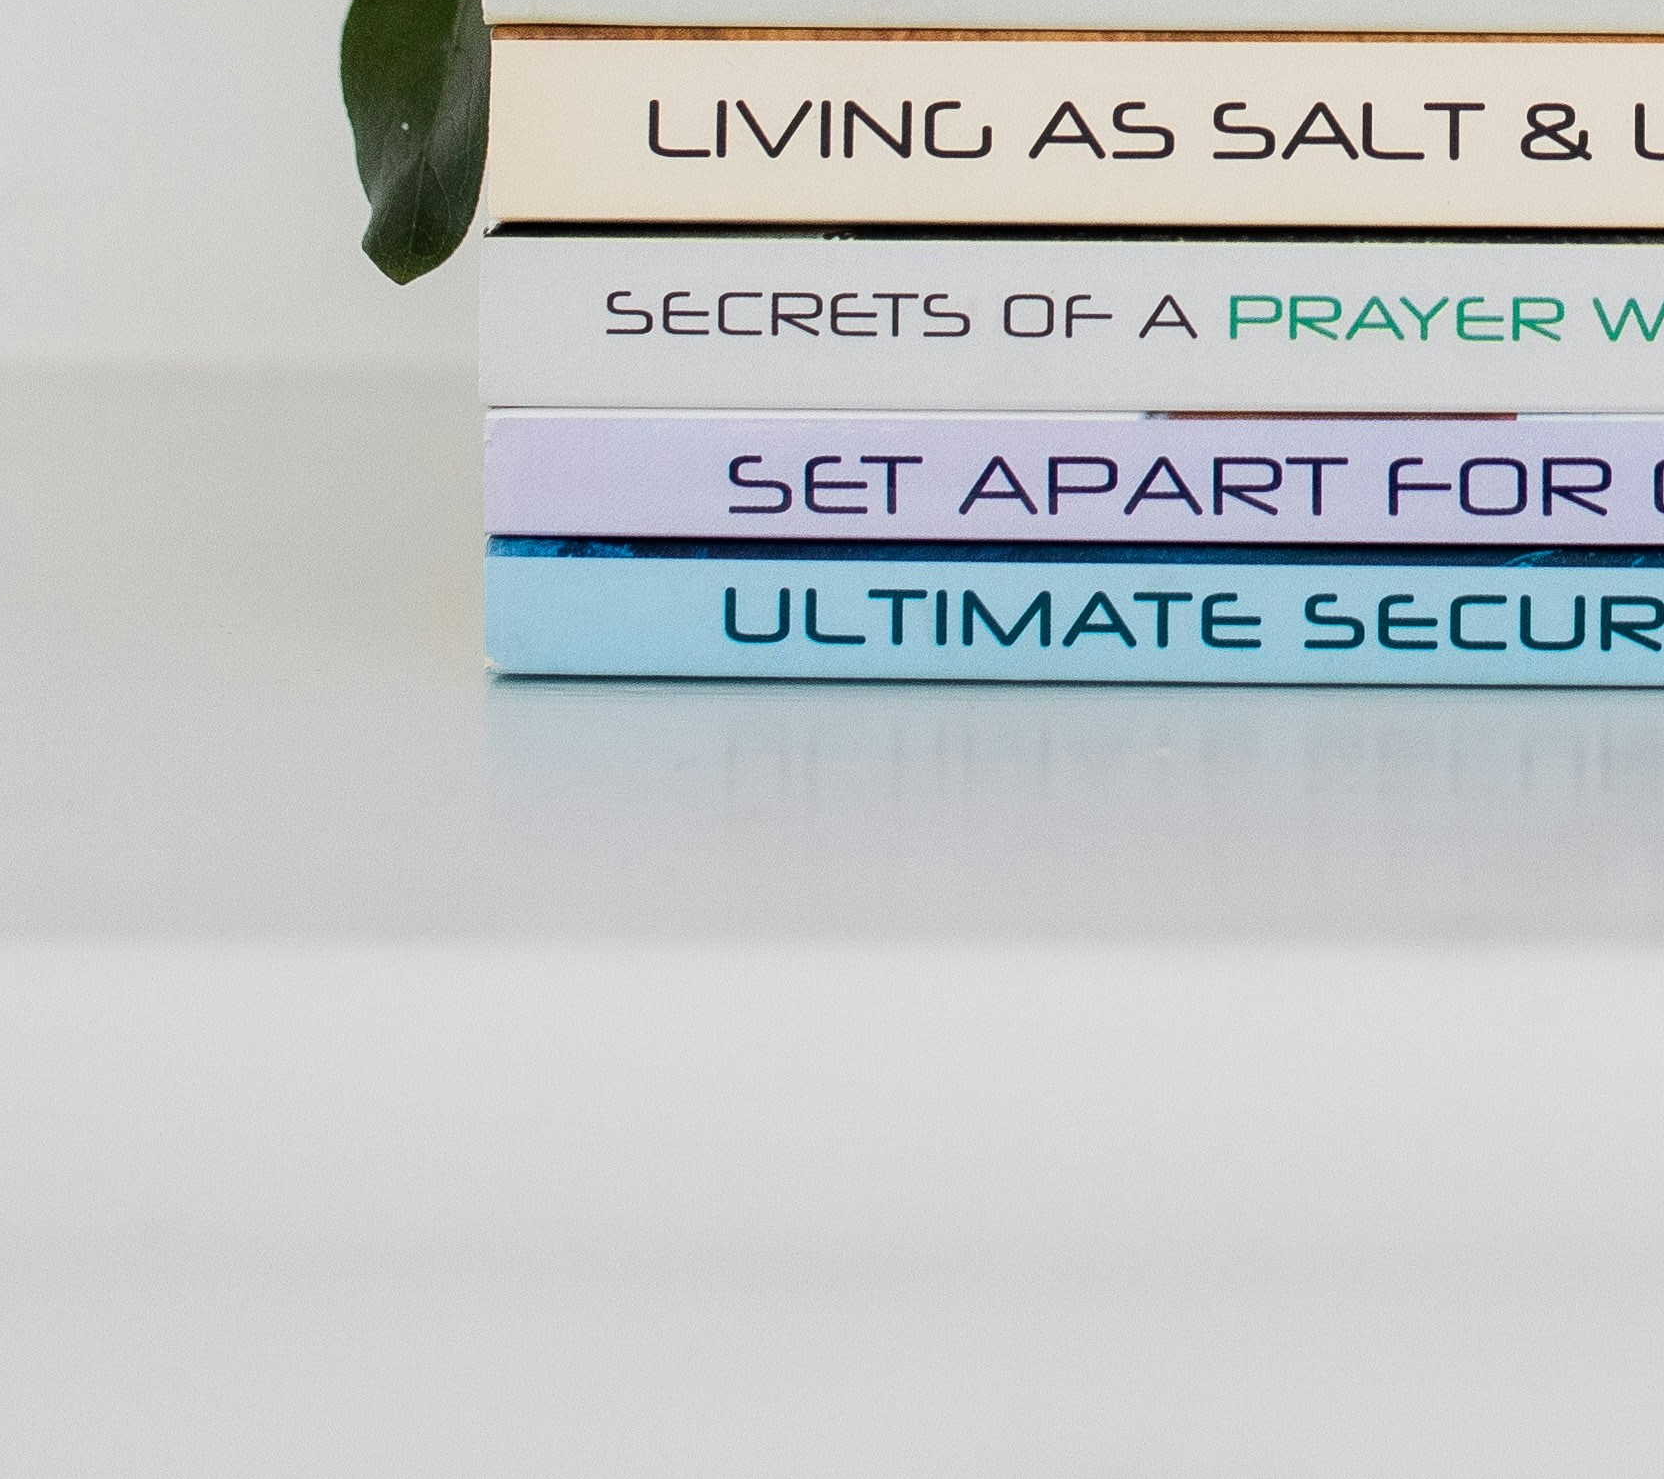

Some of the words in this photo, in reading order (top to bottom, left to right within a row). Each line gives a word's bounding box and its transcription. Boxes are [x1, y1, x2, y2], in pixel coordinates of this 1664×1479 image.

[647, 98, 993, 160] LIVING
[1027, 100, 1176, 161] AS
[1212, 100, 1486, 162] SALT
[1519, 102, 1593, 162] &
[605, 289, 972, 339] SECRETS
[1002, 292, 1114, 340] OF
[1138, 293, 1199, 340] A
[1228, 294, 1566, 343] PRAYER
[727, 454, 924, 516] SET
[957, 455, 1350, 517] APART
[1387, 456, 1613, 518] FOR
[722, 586, 1263, 652] ULTIMATE
